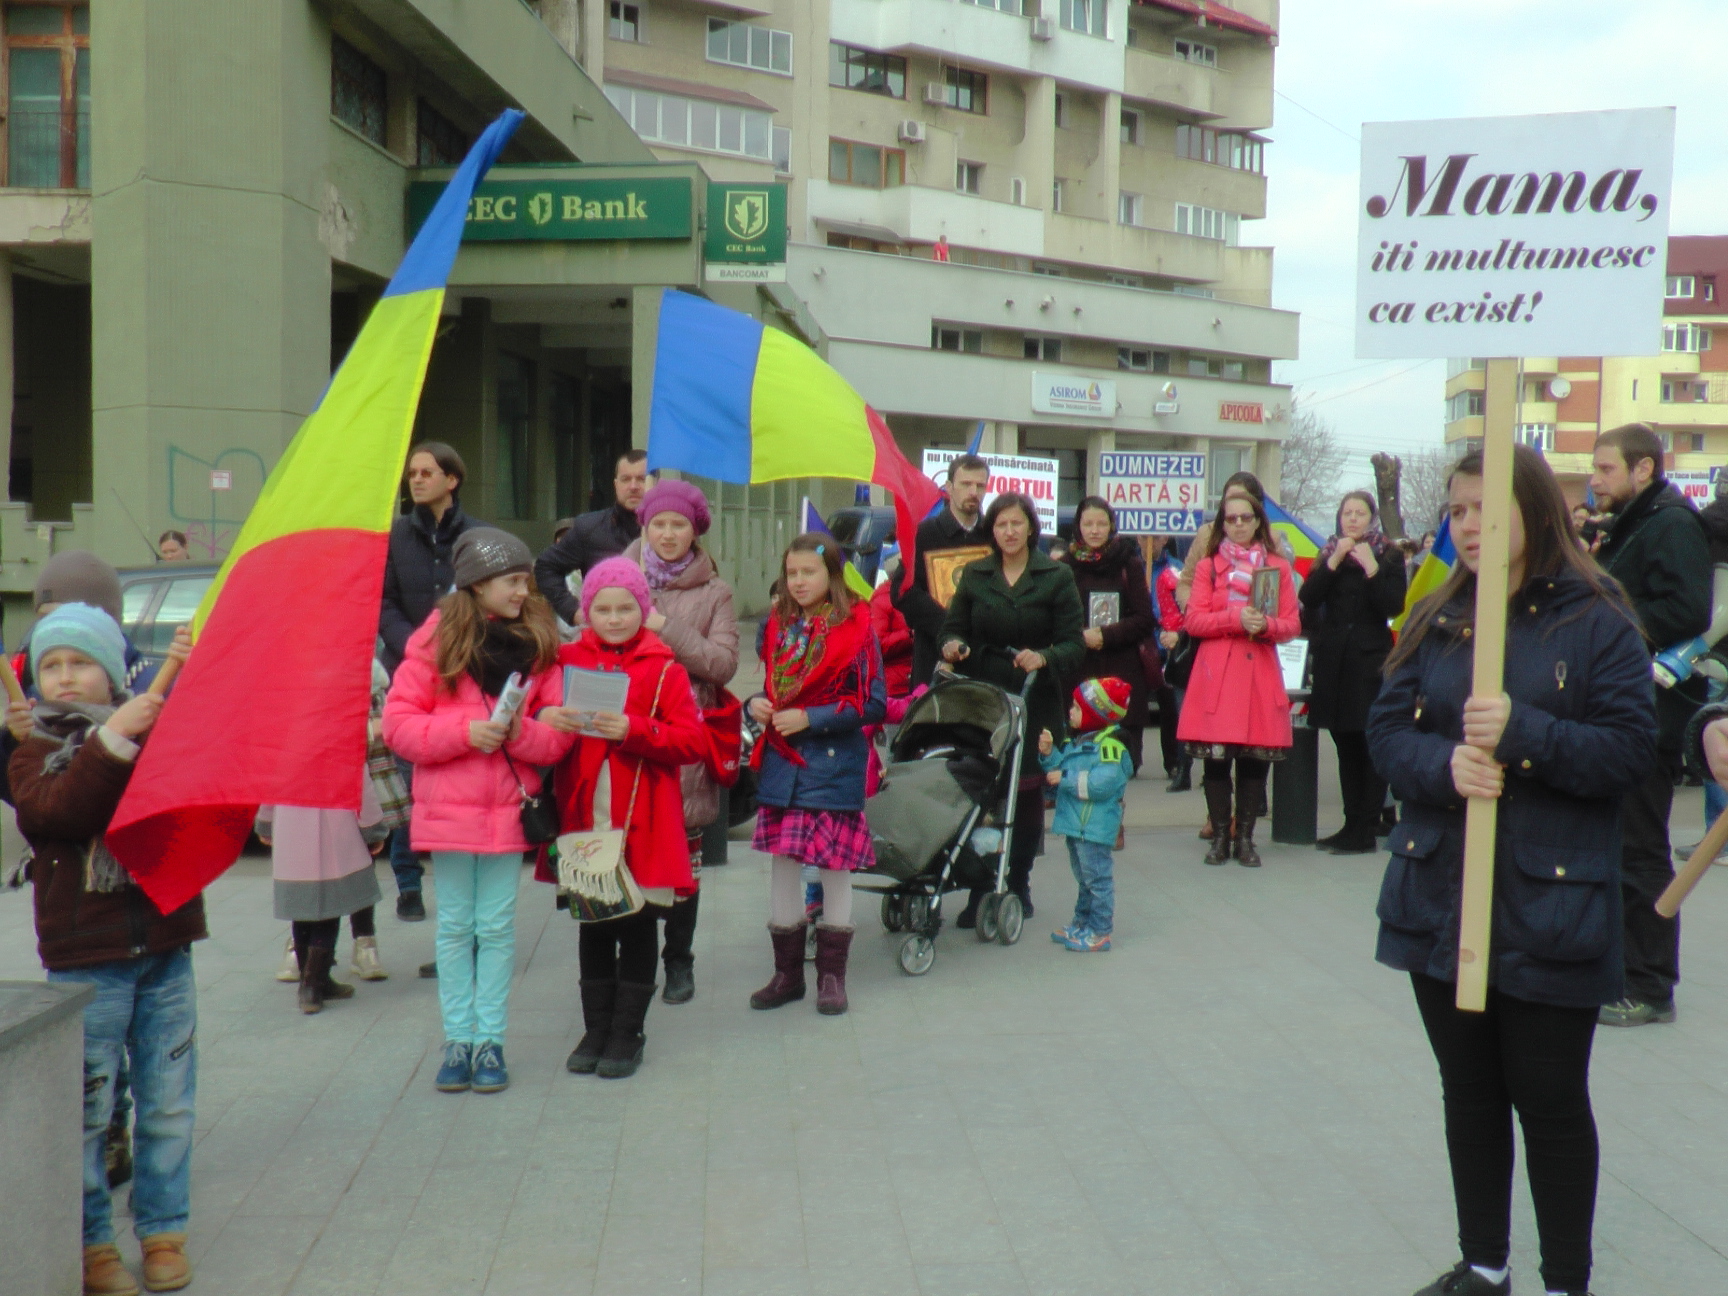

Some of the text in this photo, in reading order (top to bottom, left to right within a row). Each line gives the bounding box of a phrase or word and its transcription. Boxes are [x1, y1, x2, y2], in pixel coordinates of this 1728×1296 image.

[1366, 153, 1658, 222] Mama,
[561, 192, 648, 220] Bank
[726, 243, 767, 253] CEC Bank
[1371, 238, 1656, 272] iti multumesc
[720, 269, 769, 278] BANCOMAT
[1368, 290, 1543, 323] ca exist!
[1049, 386, 1087, 400] ASIROM
[1219, 402, 1263, 422] APICOLA
[927, 452, 941, 463] nu
[1102, 455, 1205, 476] DUMNEZEU
[985, 475, 1055, 500] VORTUL
[1106, 479, 1172, 503] IARTĂ
[1684, 484, 1708, 497] AVO
[1036, 506, 1055, 517] ama
[1114, 508, 1198, 531] INDECĂ
